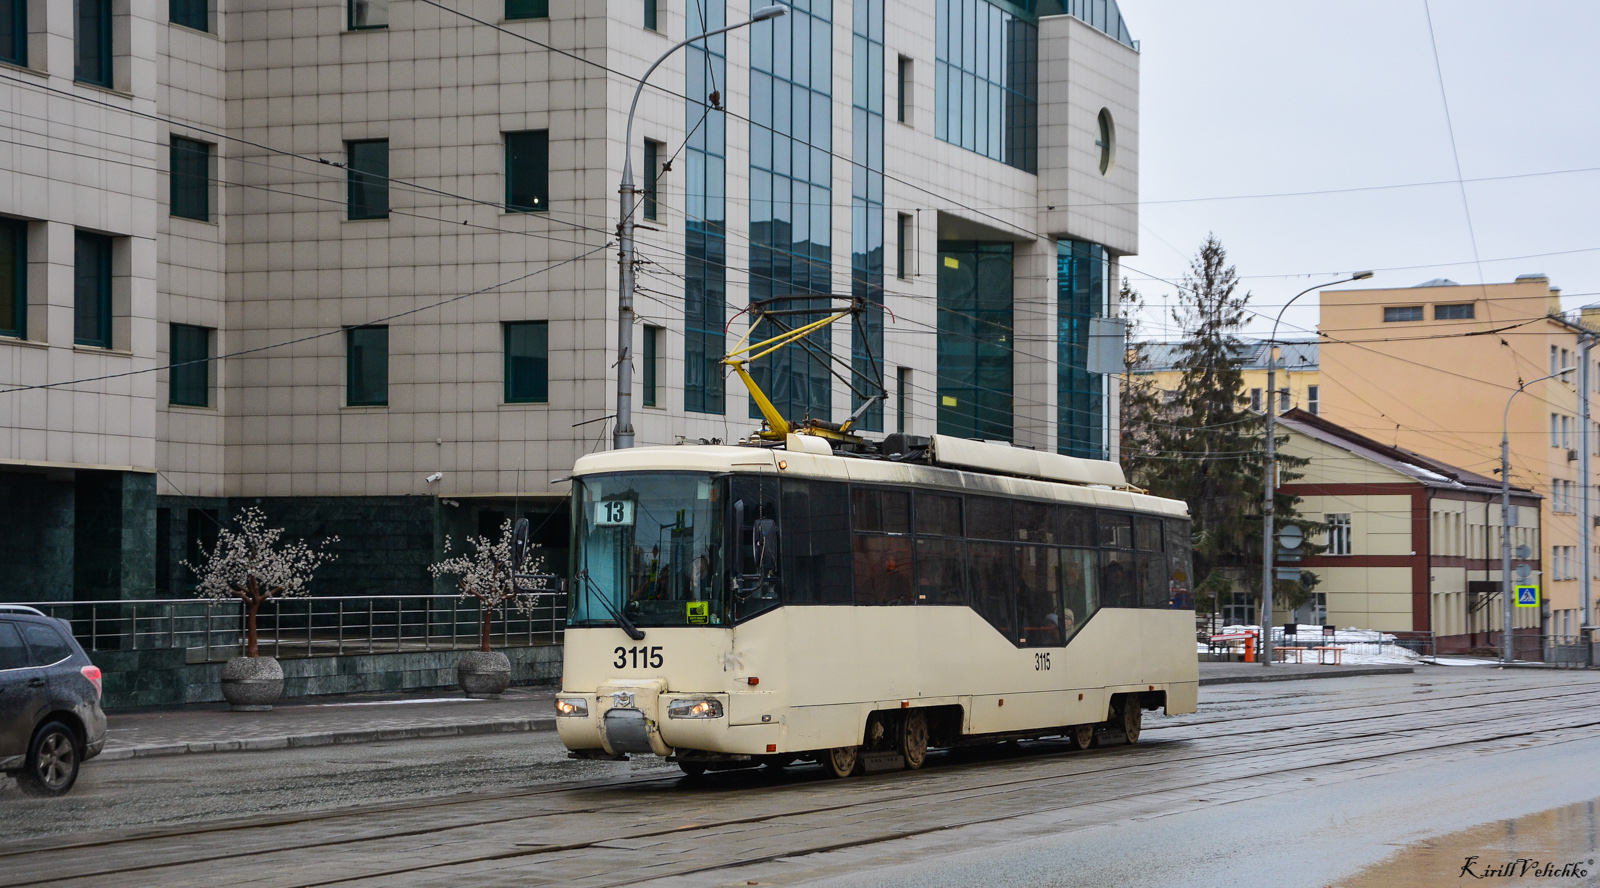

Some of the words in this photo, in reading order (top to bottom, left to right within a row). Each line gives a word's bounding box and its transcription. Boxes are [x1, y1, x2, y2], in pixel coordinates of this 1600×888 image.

[604, 501, 625, 523] 13
[613, 646, 664, 669] 3115
[1034, 652, 1051, 671] 3115
